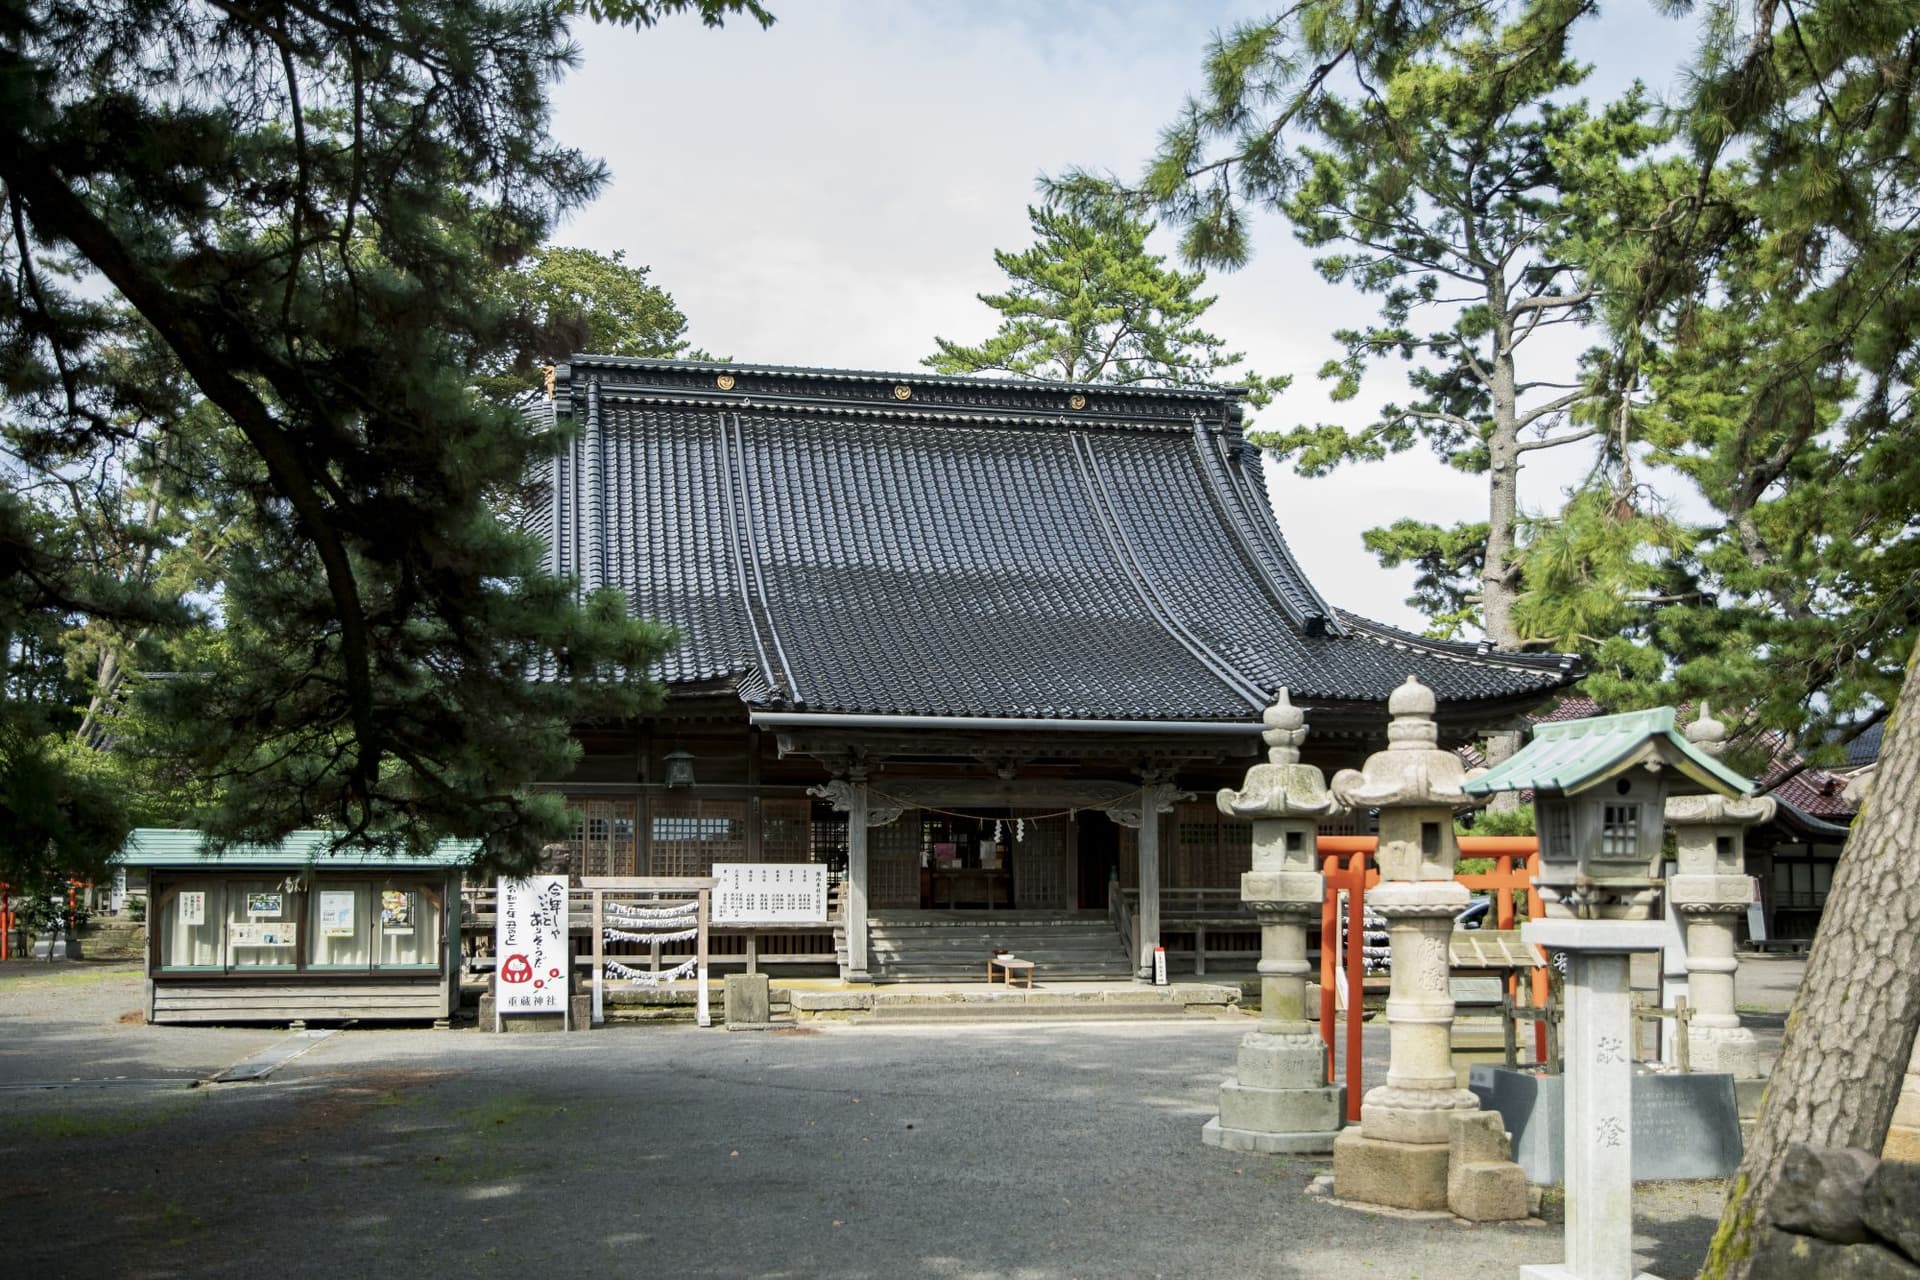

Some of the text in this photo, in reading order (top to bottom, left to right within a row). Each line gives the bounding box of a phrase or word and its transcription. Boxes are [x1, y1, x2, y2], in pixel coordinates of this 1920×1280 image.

[538, 893, 552, 927] いいこと
[530, 910, 547, 968] ありそうだ
[508, 995, 556, 1008] 重蔵神社
